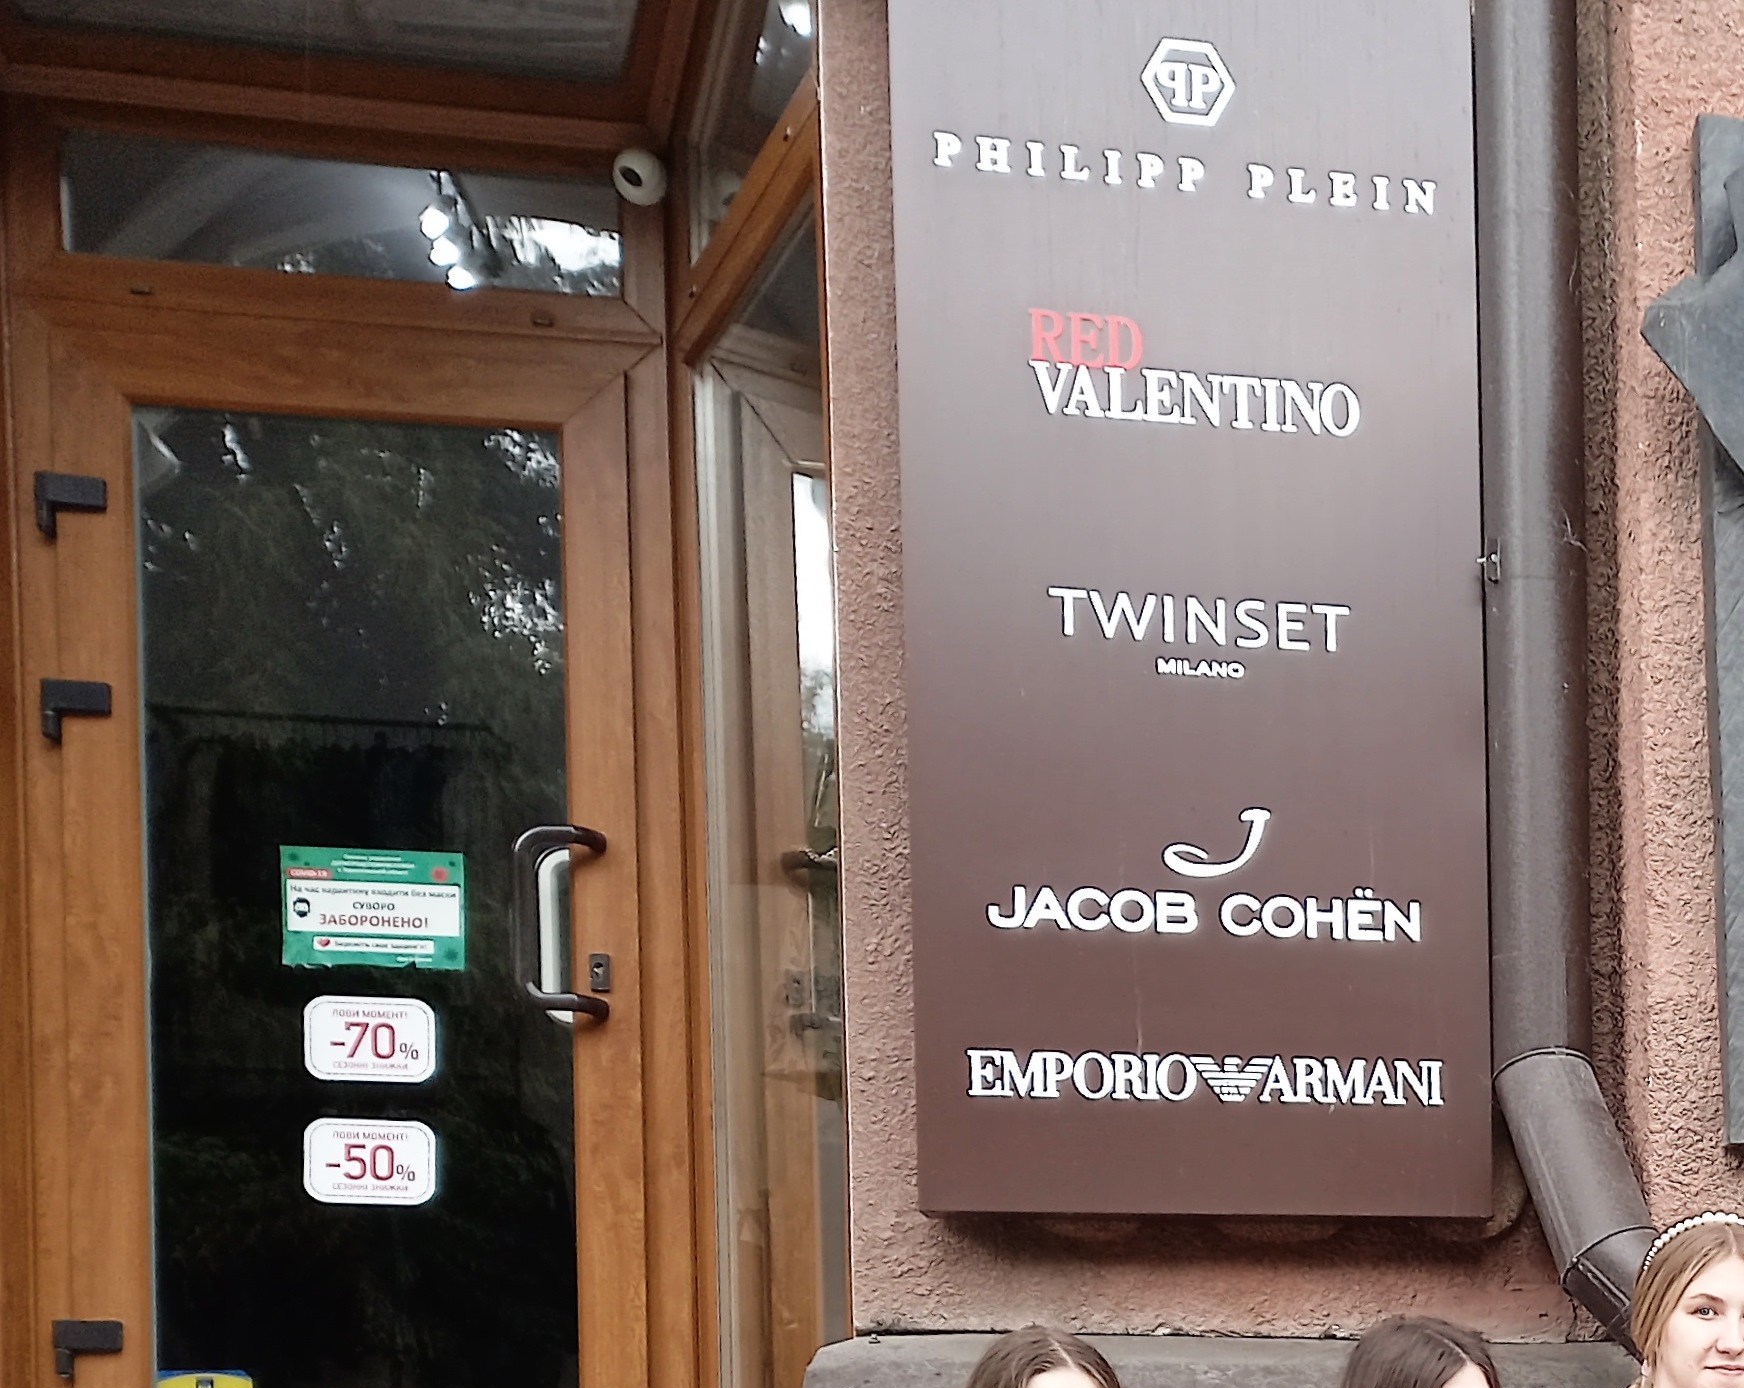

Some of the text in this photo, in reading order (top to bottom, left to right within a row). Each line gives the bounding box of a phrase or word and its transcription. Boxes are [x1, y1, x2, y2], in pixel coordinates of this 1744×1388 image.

[933, 131, 1438, 215] PHILIPP PLEIN
[1028, 308, 1143, 369] RED
[1028, 359, 1361, 437] VALENTINO
[1047, 586, 1351, 654] TWINSET
[1156, 657, 1246, 680] MILANO
[319, 913, 429, 929] ЗАБОРОНЕНО!
[987, 886, 1422, 943] JACOB COHËN
[966, 1047, 1445, 1108] EMPORIO ARMANI
